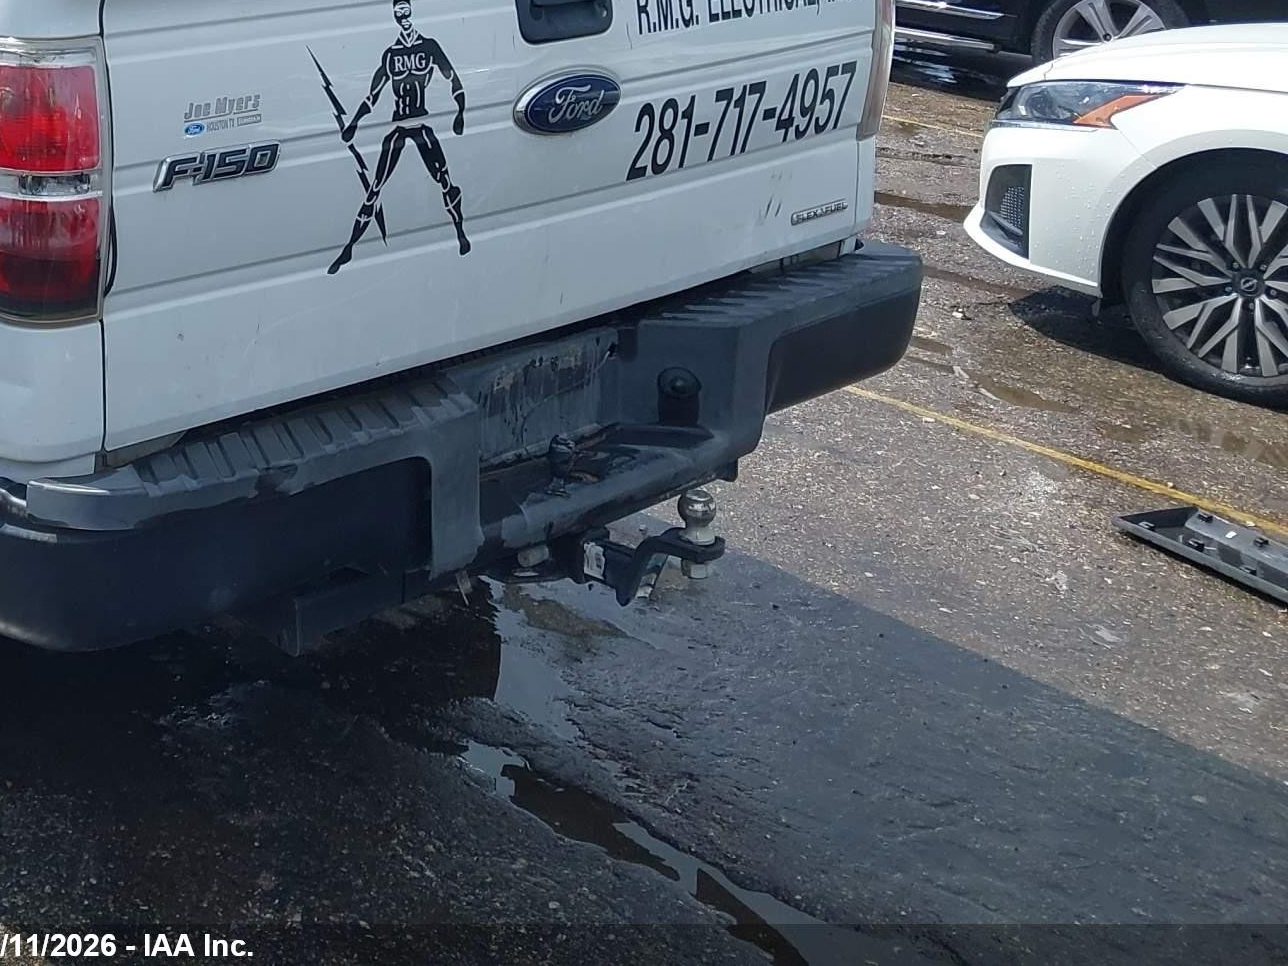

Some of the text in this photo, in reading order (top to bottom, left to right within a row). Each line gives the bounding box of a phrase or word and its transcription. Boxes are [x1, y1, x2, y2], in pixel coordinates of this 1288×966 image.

[393, 52, 426, 72] RMG
[183, 94, 261, 120] Joe Myers
[548, 84, 605, 123] Ford
[625, 60, 858, 182] 281-717-4957
[152, 140, 280, 192] F-150
